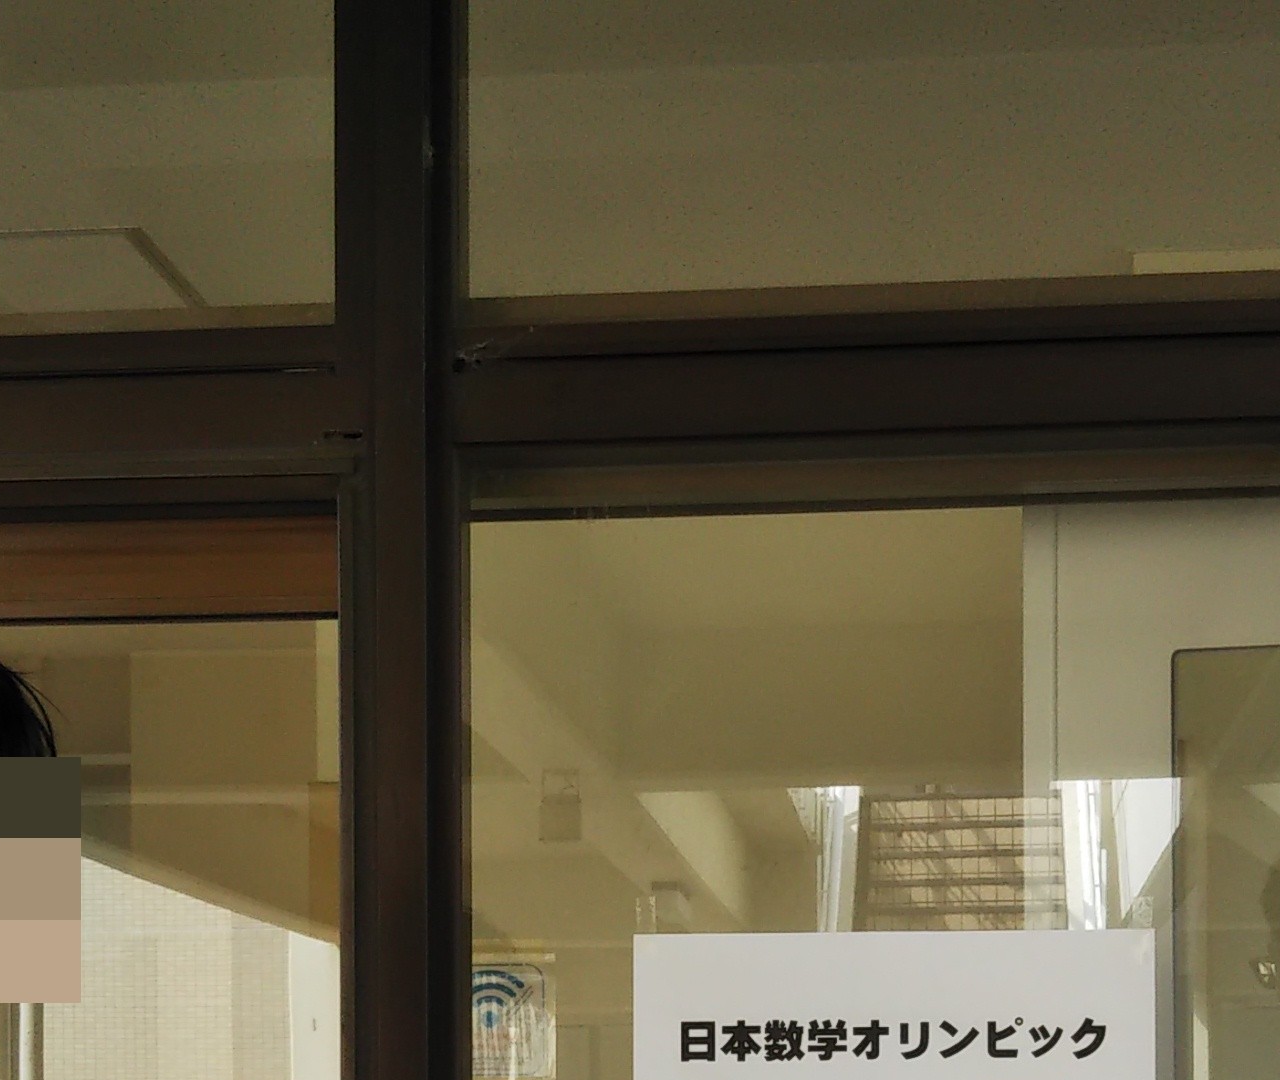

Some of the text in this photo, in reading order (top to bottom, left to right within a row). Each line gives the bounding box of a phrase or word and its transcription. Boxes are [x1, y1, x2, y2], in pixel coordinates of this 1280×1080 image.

[679, 1016, 1107, 1062] 日本数学オリンピック
